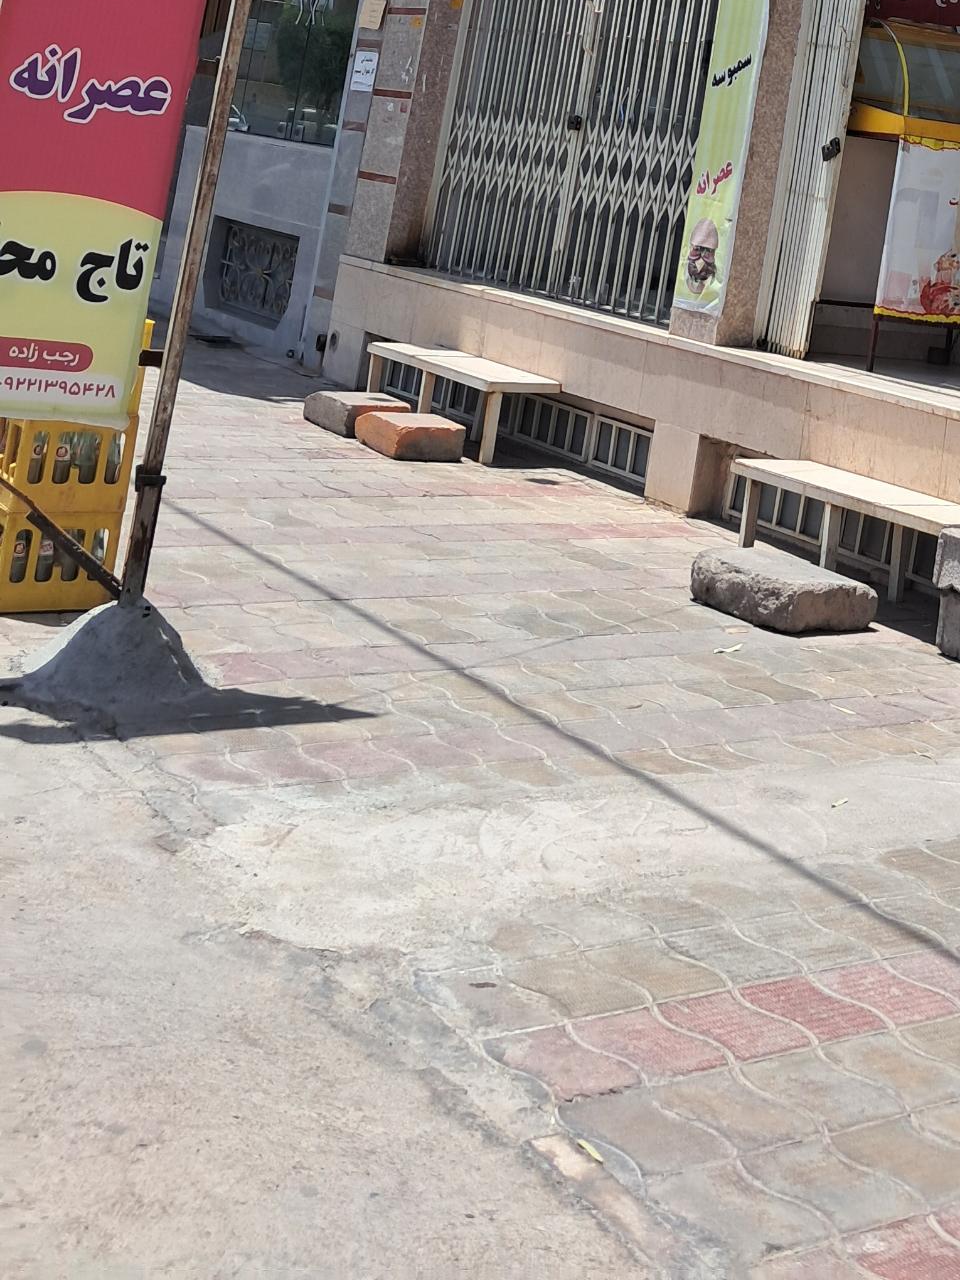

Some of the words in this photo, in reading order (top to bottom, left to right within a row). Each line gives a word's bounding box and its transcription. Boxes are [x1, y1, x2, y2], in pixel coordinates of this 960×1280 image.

[9, 43, 172, 123] عصرانه
[0, 240, 57, 281] مح
[76, 238, 150, 302] تاج
[9, 342, 39, 362] زاده
[43, 348, 80, 366] رجب
